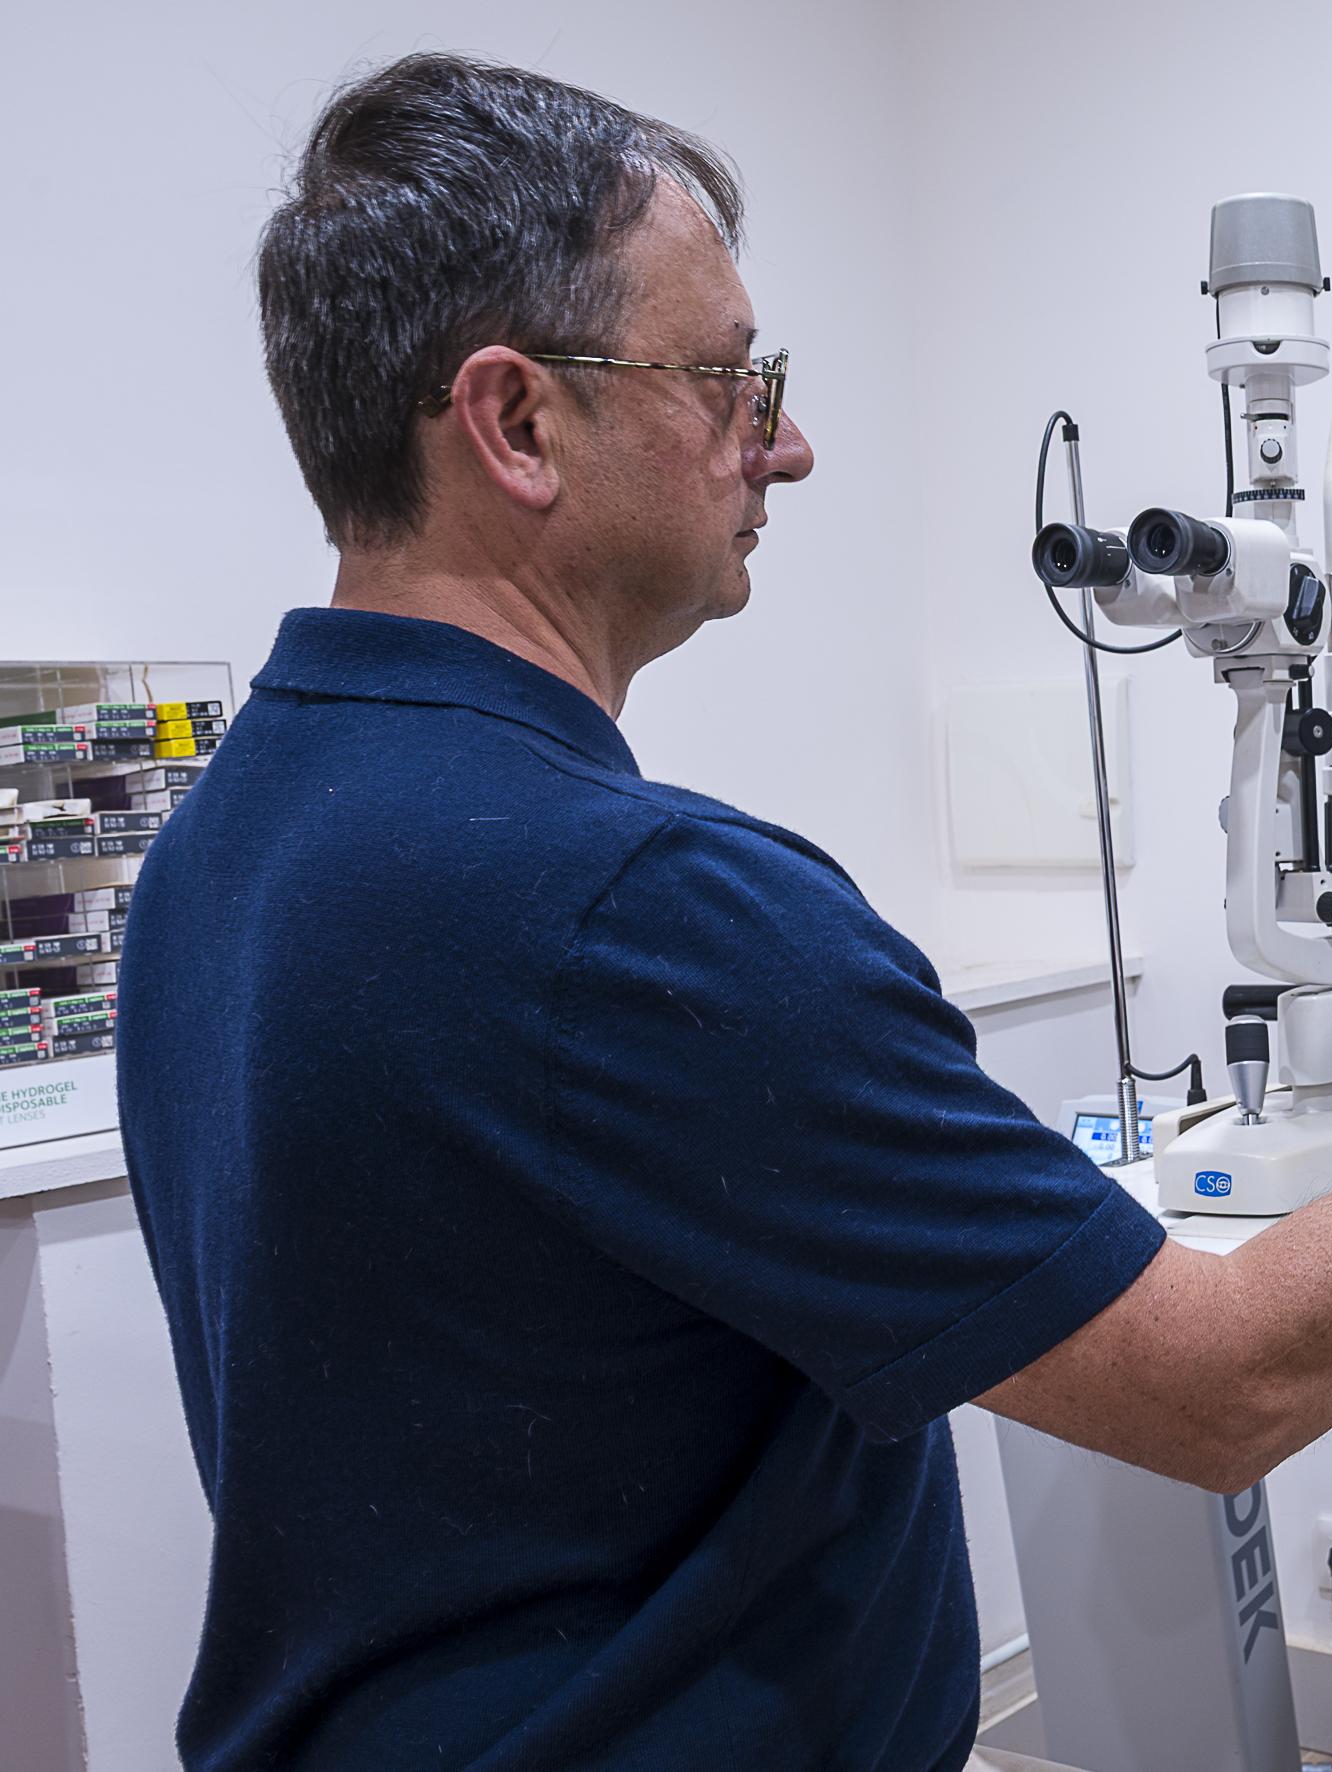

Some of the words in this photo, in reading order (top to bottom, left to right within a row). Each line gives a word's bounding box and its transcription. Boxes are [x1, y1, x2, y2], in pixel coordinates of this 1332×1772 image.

[11, 1080, 78, 1100] HYDROGEL
[0, 1094, 68, 1113] ISPOSABLE
[8, 1109, 46, 1124] LENSES
[1195, 1174, 1231, 1193] CSO
